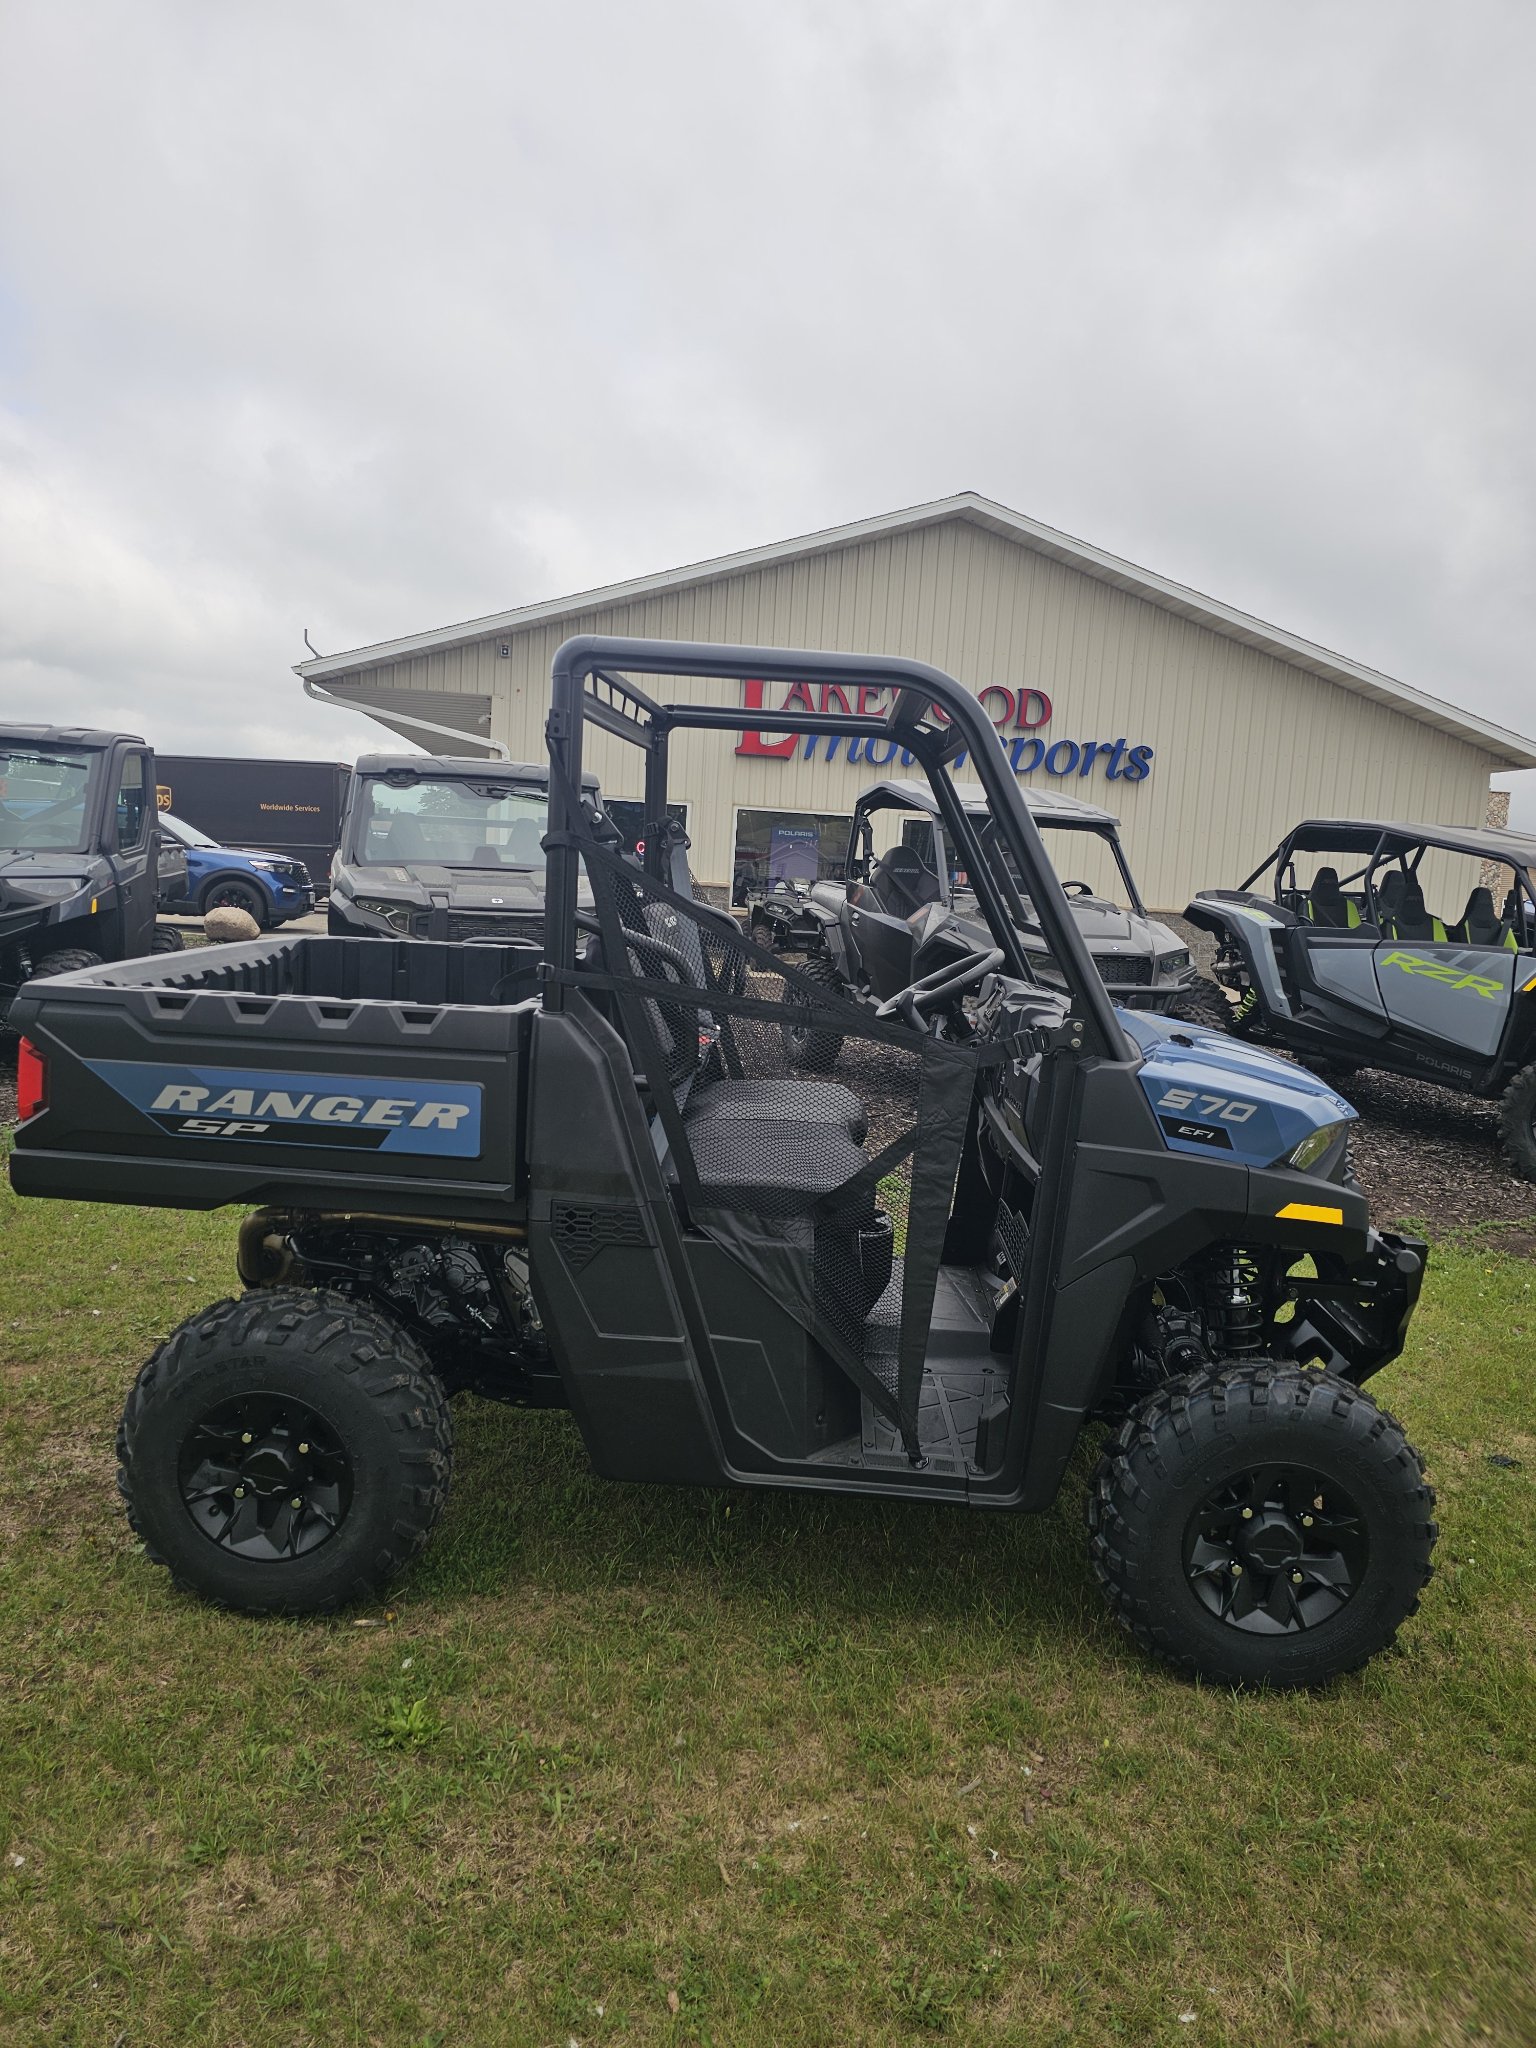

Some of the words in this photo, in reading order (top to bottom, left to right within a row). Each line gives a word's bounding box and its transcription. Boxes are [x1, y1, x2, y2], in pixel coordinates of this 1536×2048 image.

[735, 679, 1053, 760] LAKEOD
[260, 803, 293, 812] Worldwide
[294, 804, 321, 813] Services
[778, 829, 814, 838] POLARIS
[1380, 951, 1504, 1000] RZR
[1416, 1052, 1472, 1080] POLARIS
[150, 1084, 471, 1130] RANGER
[177, 1118, 270, 1136] SP
[1178, 1126, 1215, 1139] EFI
